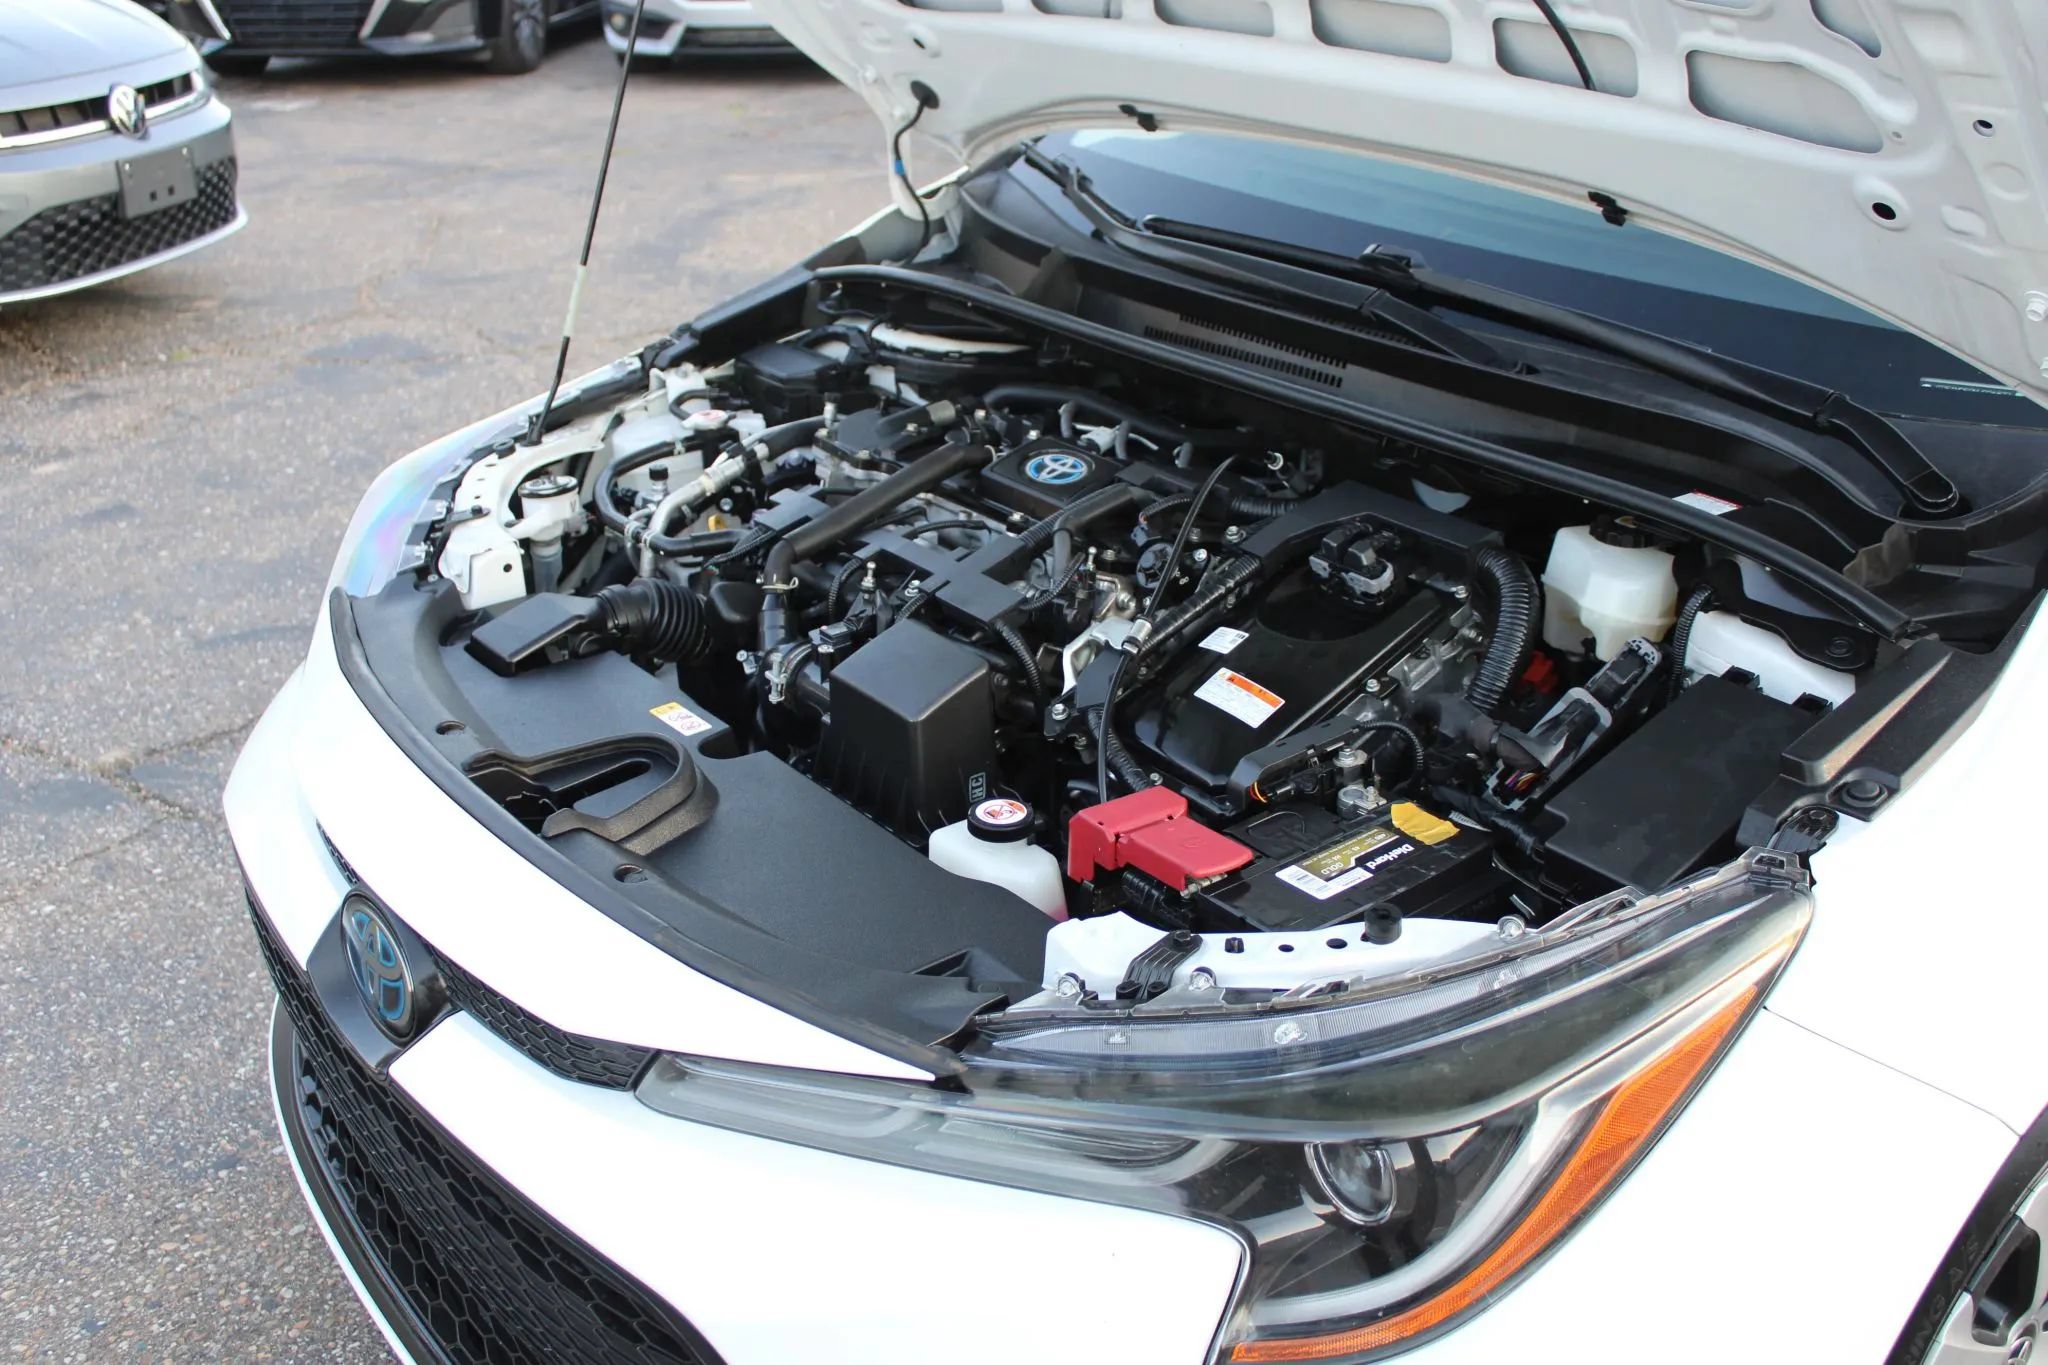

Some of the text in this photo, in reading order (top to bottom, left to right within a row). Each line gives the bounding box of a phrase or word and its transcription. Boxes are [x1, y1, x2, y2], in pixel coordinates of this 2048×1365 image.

[971, 776, 984, 799] HC
[1320, 861, 1344, 875] GOLD
[1365, 843, 1414, 870] DieHard
